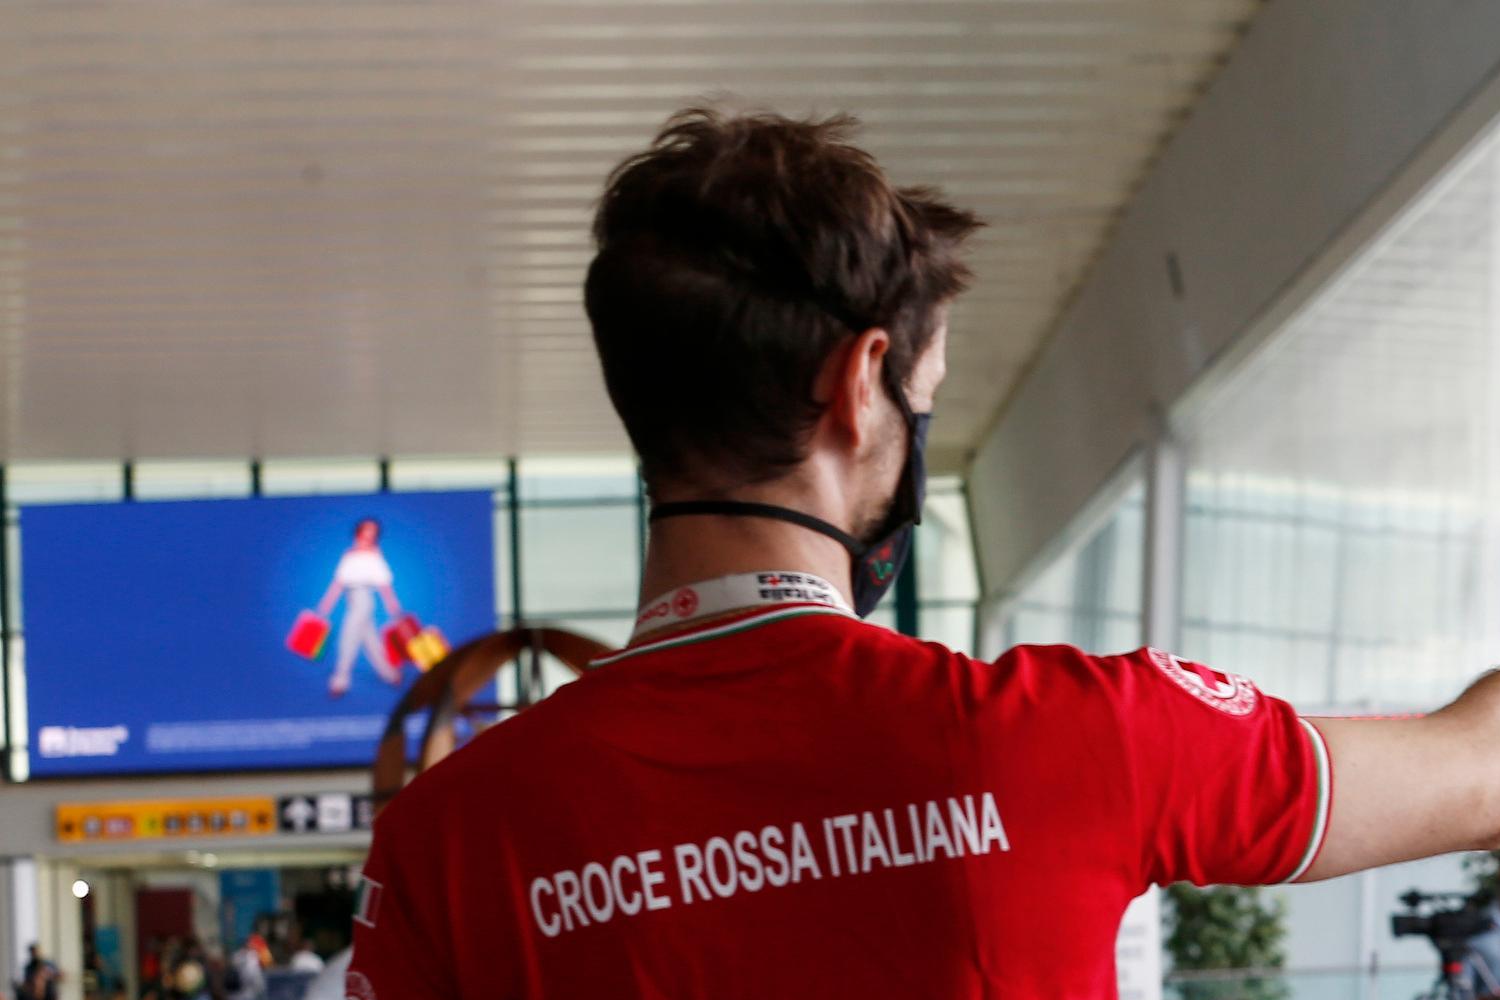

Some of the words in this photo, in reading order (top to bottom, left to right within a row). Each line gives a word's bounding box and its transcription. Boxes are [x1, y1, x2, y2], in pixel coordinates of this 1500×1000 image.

[530, 849, 671, 938] CROCE
[674, 822, 822, 904] ROSSA
[822, 792, 1011, 877] ITALIANA
